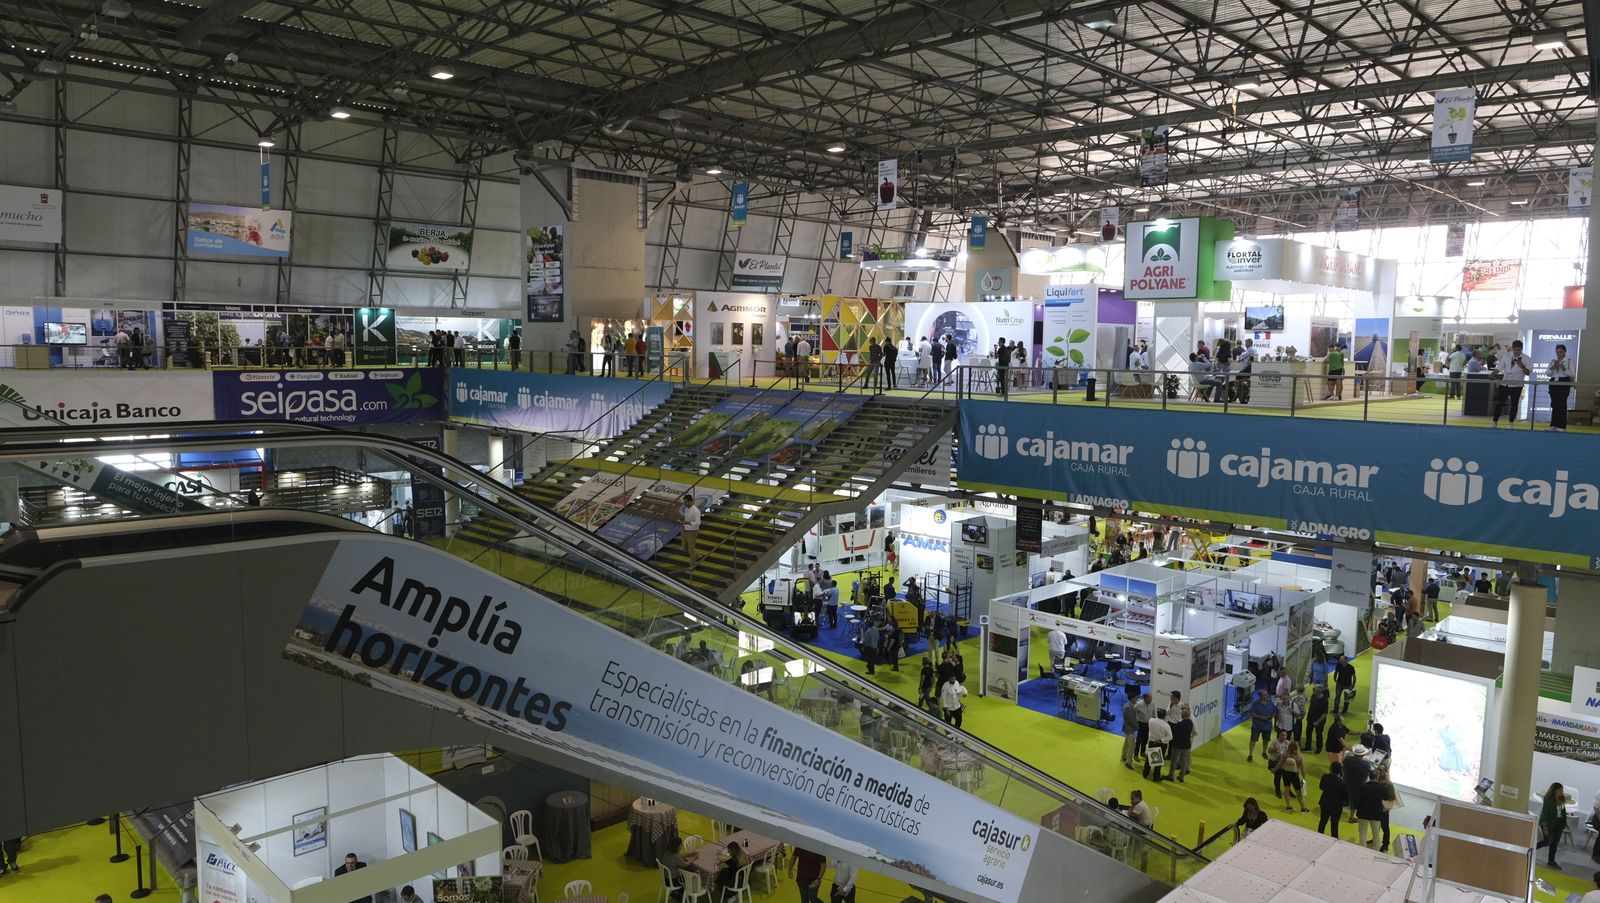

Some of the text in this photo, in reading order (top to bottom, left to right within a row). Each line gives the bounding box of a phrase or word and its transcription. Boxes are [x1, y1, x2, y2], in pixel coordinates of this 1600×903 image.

[419, 228, 446, 238] BERJA
[1227, 251, 1262, 259] FLORTAL
[1143, 266, 1174, 277] AGRI
[1130, 278, 1186, 290] POLYANE
[1046, 288, 1084, 298] Liquifert
[461, 310, 485, 318] Koppert
[721, 304, 766, 313] AGRIMOR
[469, 385, 508, 406] cajamar
[533, 390, 579, 411] cajamar
[22, 402, 181, 423] Unicaja Banco
[294, 413, 356, 423] natural technology
[1016, 430, 1135, 467] cajamar
[1070, 462, 1131, 477] CAJA RURAL
[1219, 447, 1380, 488] cajamar
[113, 472, 126, 482] El
[123, 477, 154, 496] mejor
[163, 480, 203, 495] CASI
[108, 481, 178, 513] para tu cosech
[1292, 484, 1374, 502] CAJA RURAL
[1074, 493, 1129, 510] ADNAGRO
[416, 507, 443, 519] SER
[1298, 520, 1371, 541] ADNAGRO
[350, 556, 522, 655] Amplía
[324, 604, 573, 732] horizontes
[1193, 698, 1218, 718] Olimpo
[1551, 718, 1599, 734] NAANDANJAIN
[600, 660, 930, 816] Especialistas en la financiación a medida de
[1539, 731, 1580, 746] MAESTRAS
[1580, 740, 1592, 749] DE
[1553, 744, 1566, 752] EN
[1576, 749, 1600, 759] CAMP
[589, 688, 922, 836] transmisión y reconversión de fincas rústicas
[972, 819, 1021, 850] cajasur
[986, 844, 1011, 860] servicio
[982, 854, 1006, 869] agrario
[976, 874, 1005, 889] cajasur.es
[436, 893, 470, 901] Somos
